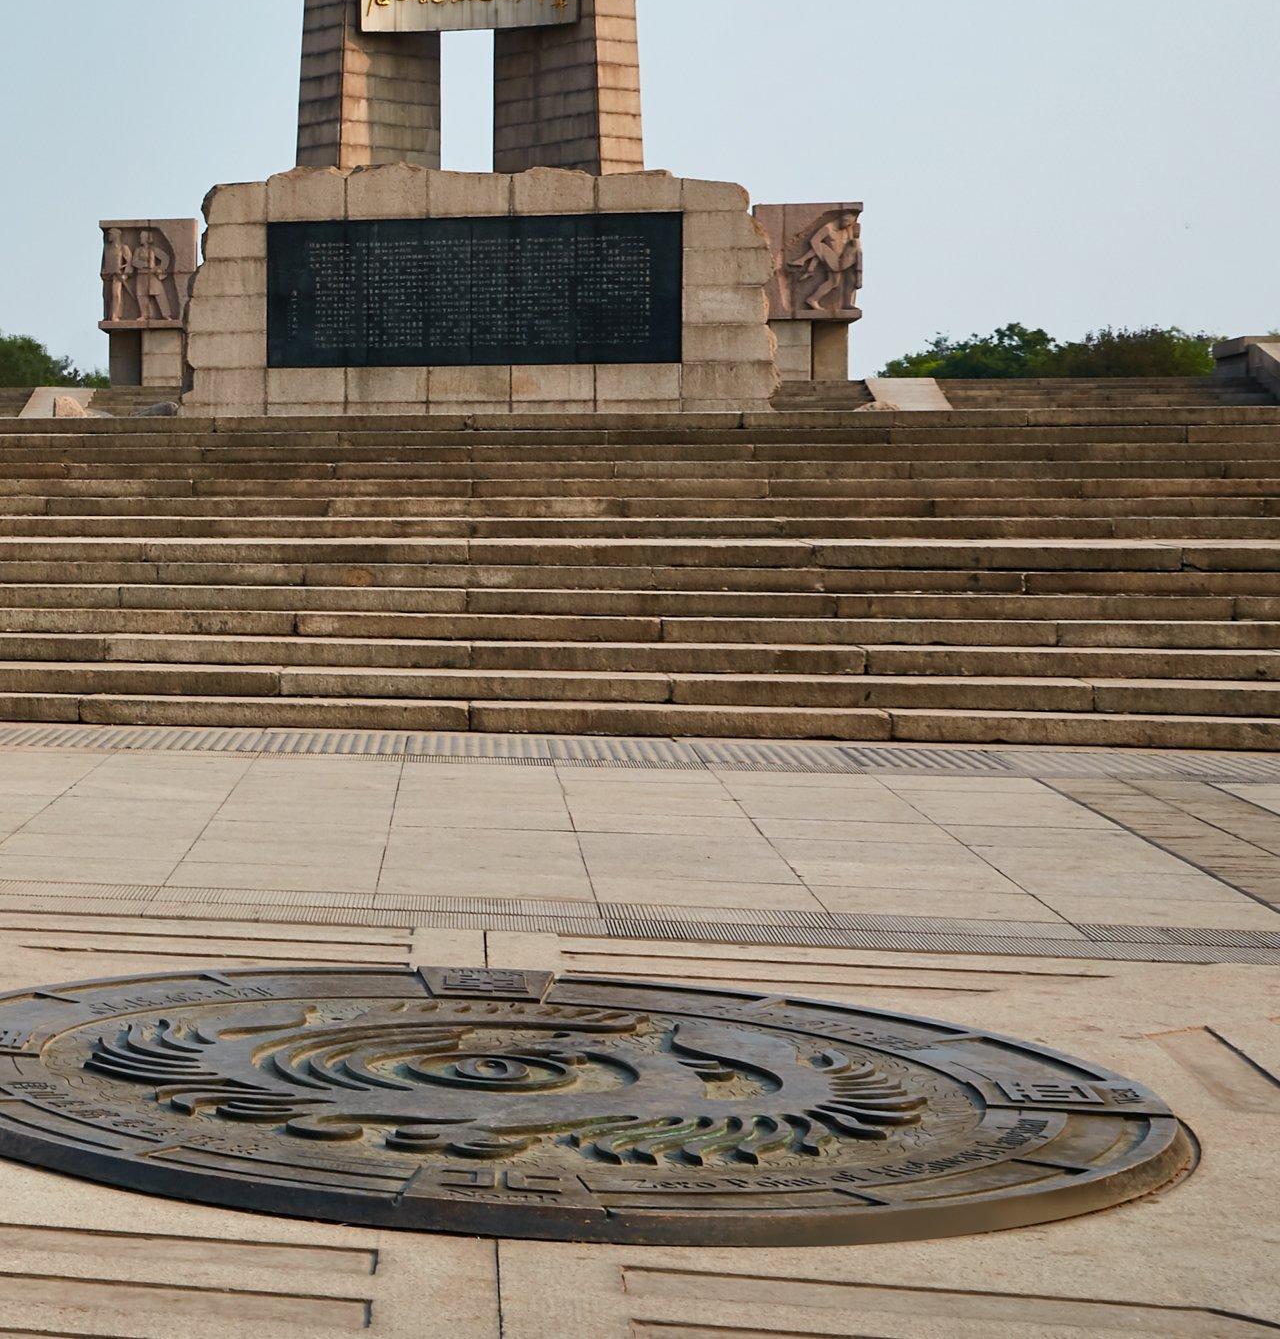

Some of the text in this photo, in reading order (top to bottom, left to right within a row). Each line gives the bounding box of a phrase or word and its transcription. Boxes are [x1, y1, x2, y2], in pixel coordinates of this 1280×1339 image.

[621, 1177, 717, 1190] Zero
[719, 1175, 826, 1190] Point
[830, 1170, 871, 1184] of
